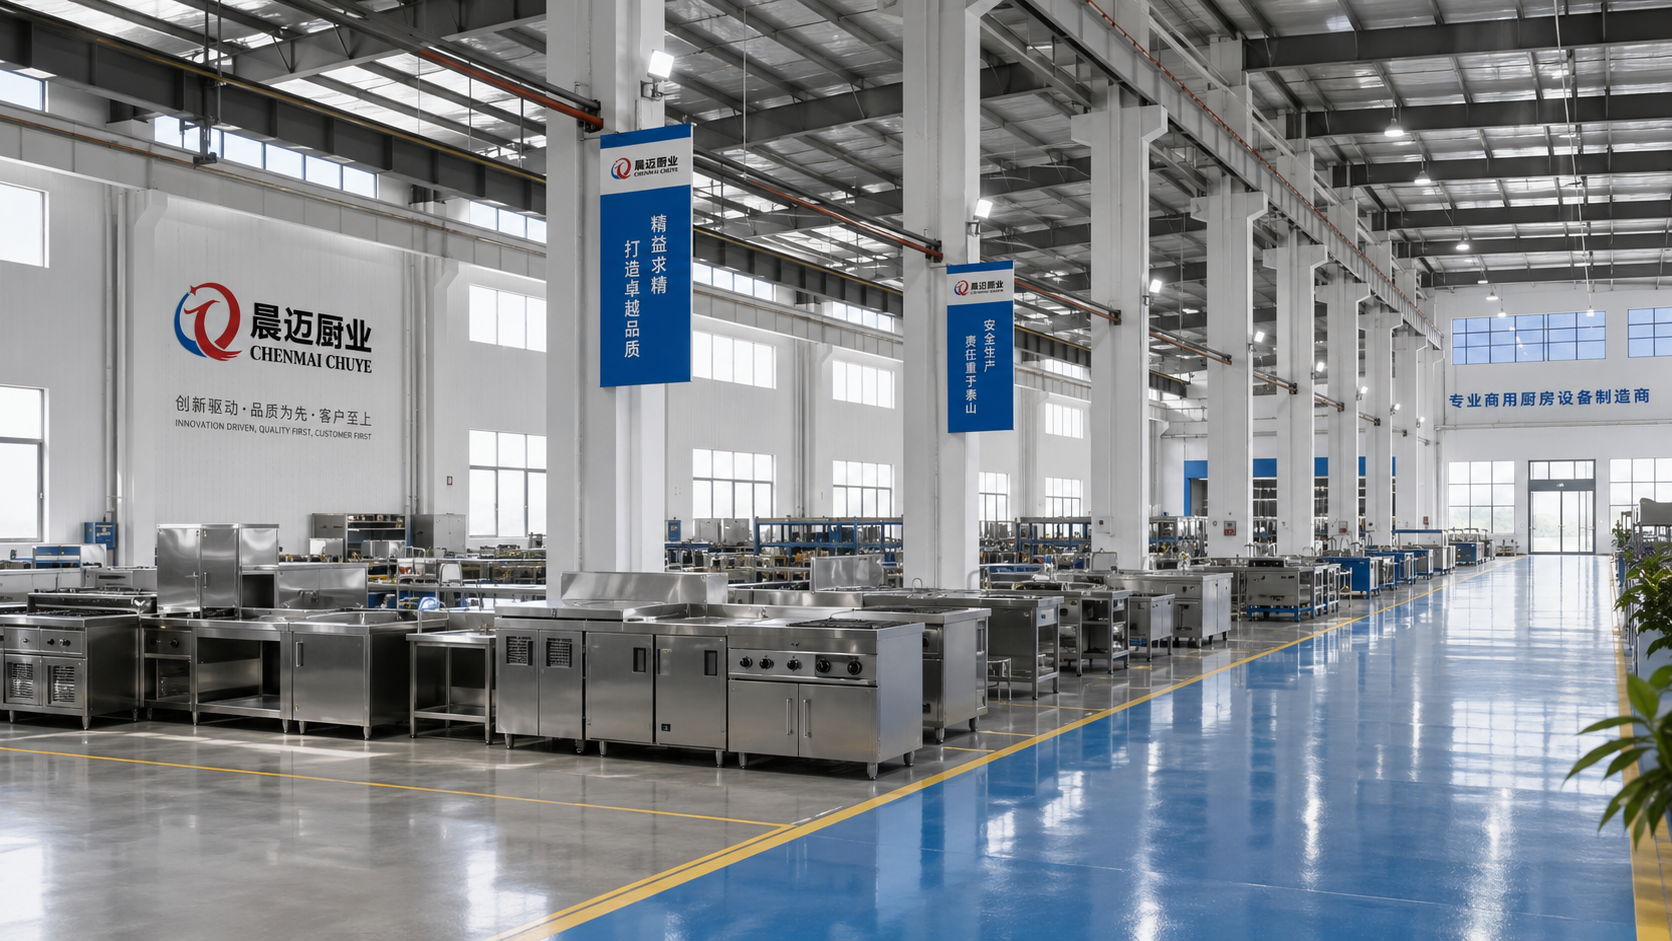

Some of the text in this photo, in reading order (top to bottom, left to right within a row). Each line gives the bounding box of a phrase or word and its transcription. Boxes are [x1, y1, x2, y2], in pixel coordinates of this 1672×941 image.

[650, 214, 667, 295] 精益求精
[624, 240, 640, 358] 打造卓越品质
[250, 302, 372, 353] 晨迈厨业
[984, 318, 996, 373] 安全生产
[250, 345, 372, 374] CHENMAI CHUYE
[1449, 387, 1650, 409] 专业商用厨房设备制造商
[175, 419, 372, 441] INNOVATION DRIVEN, QUALITY FIRST, CUSTOMER FIRST
